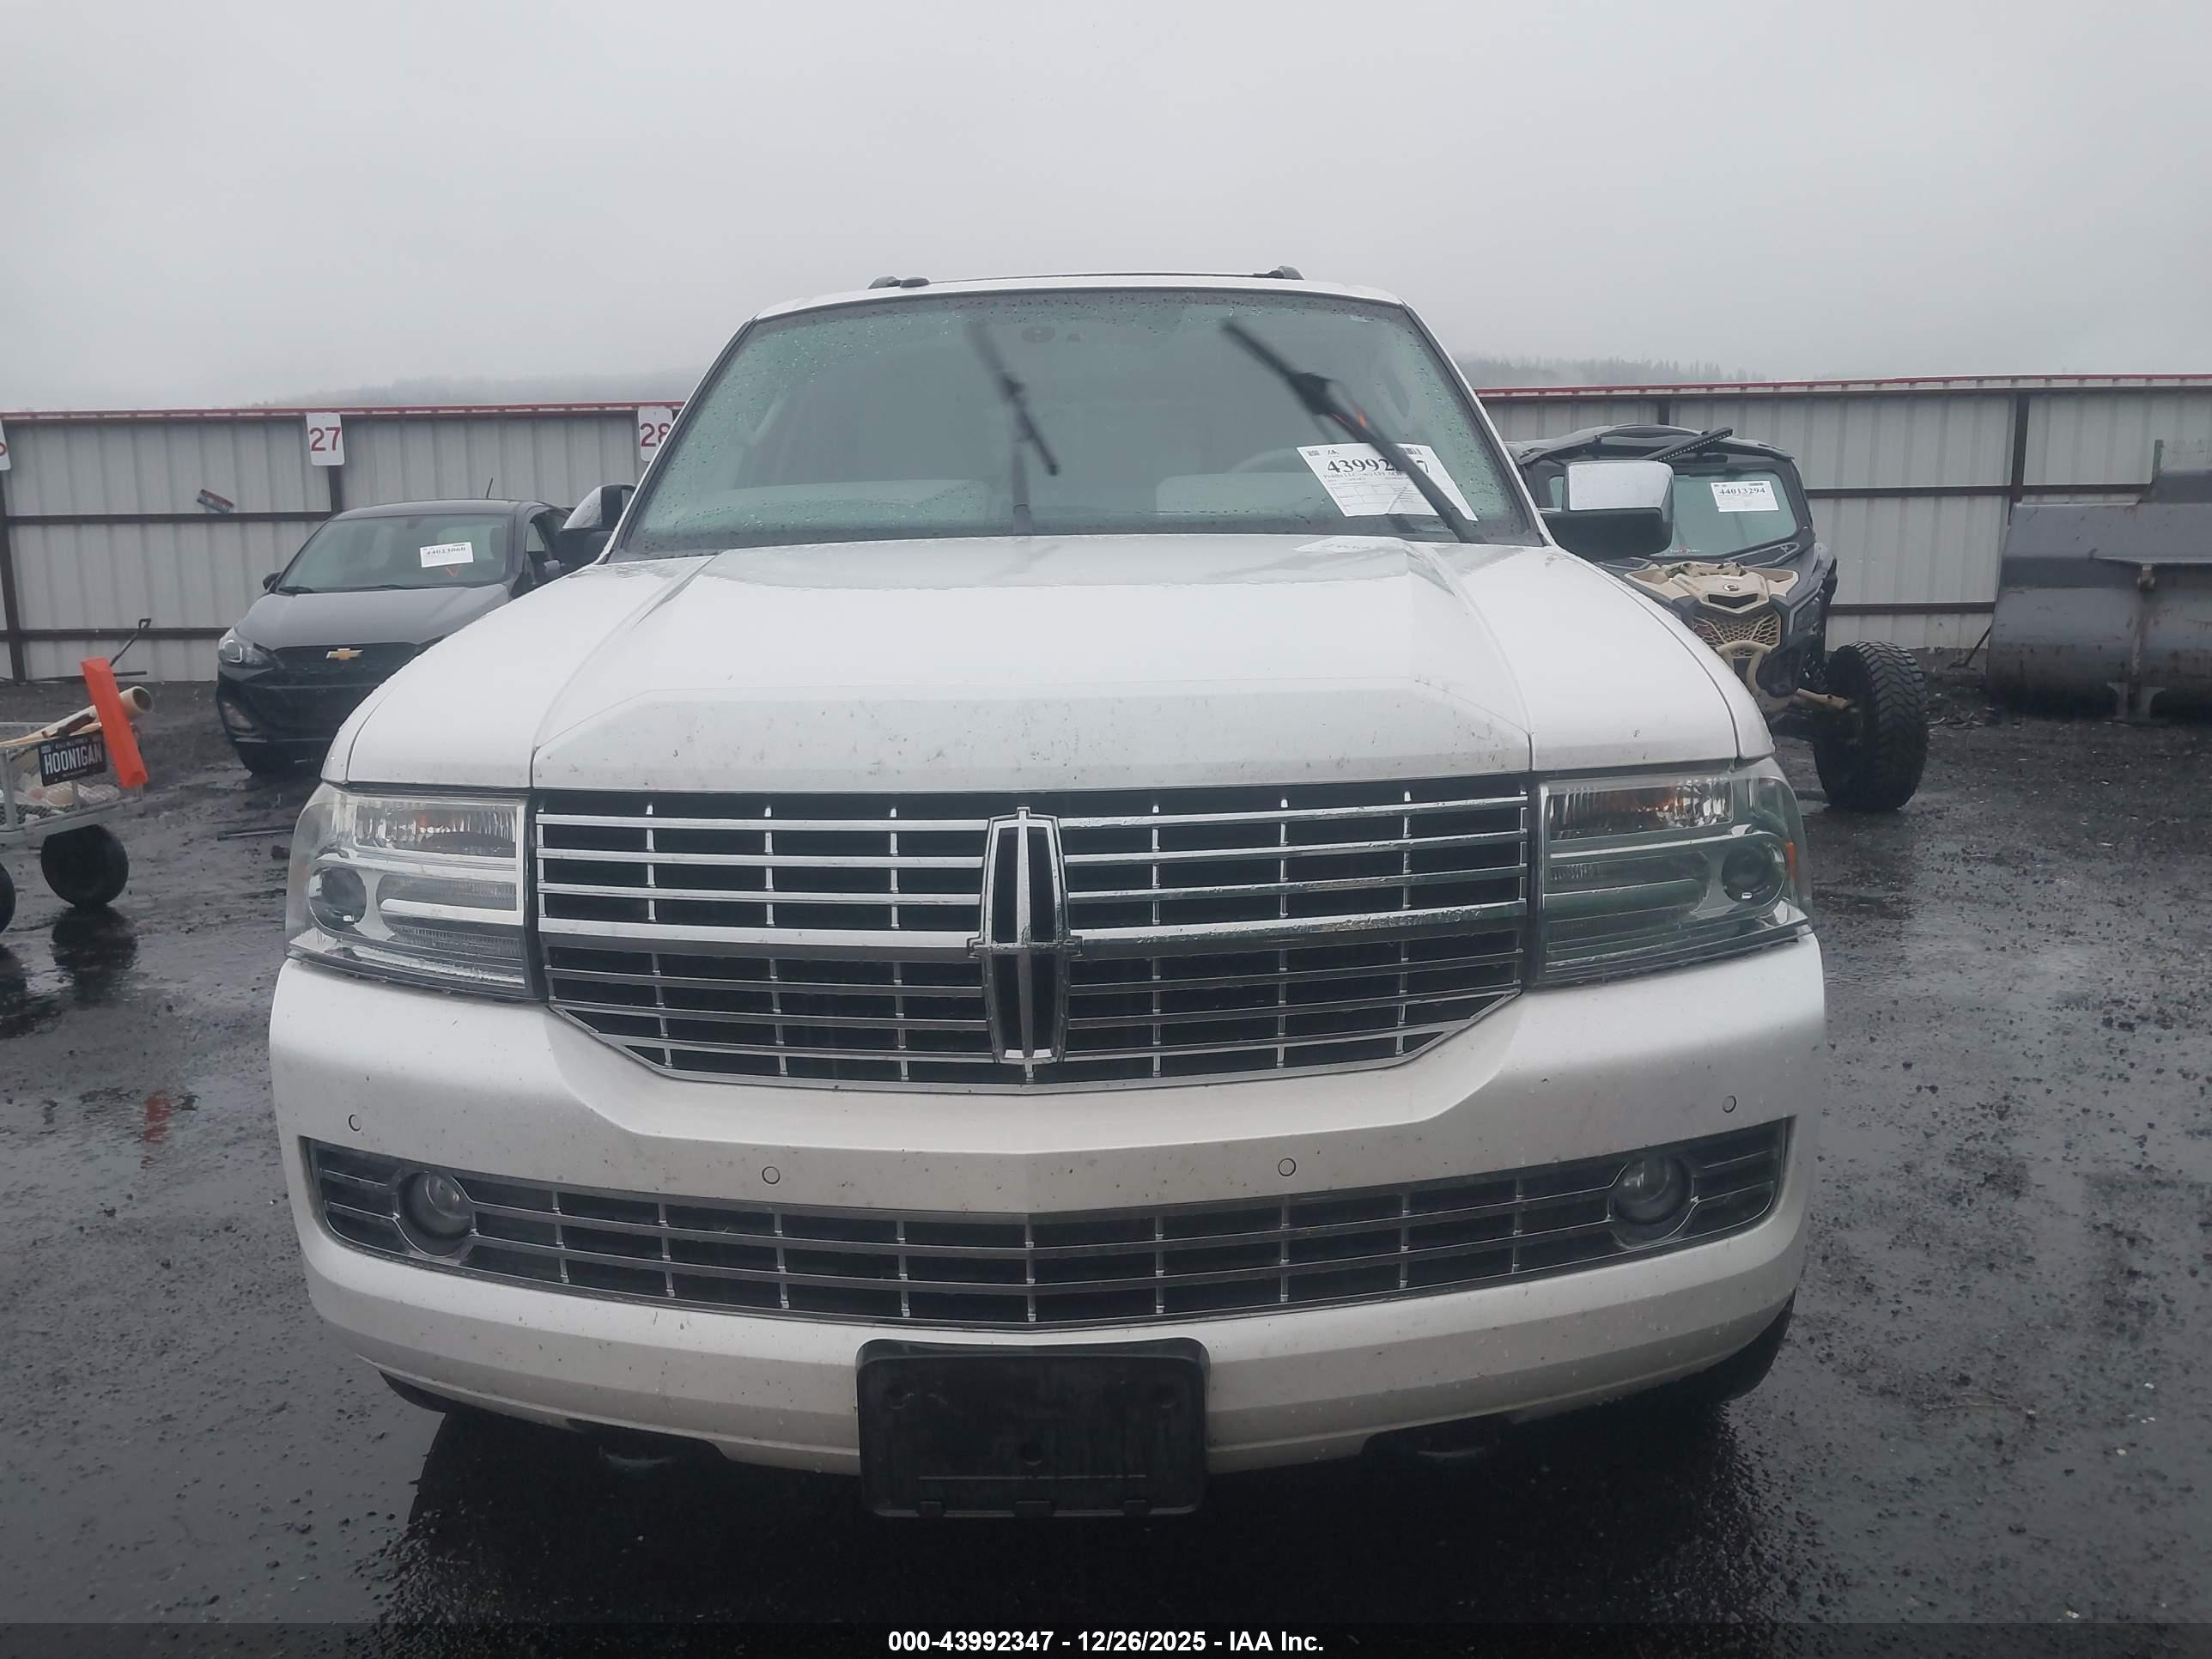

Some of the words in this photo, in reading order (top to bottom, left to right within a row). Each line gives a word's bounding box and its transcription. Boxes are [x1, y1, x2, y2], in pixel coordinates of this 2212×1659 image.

[310, 426, 341, 452] 27
[640, 422, 671, 447] 28
[1327, 459, 1429, 473] 439927
